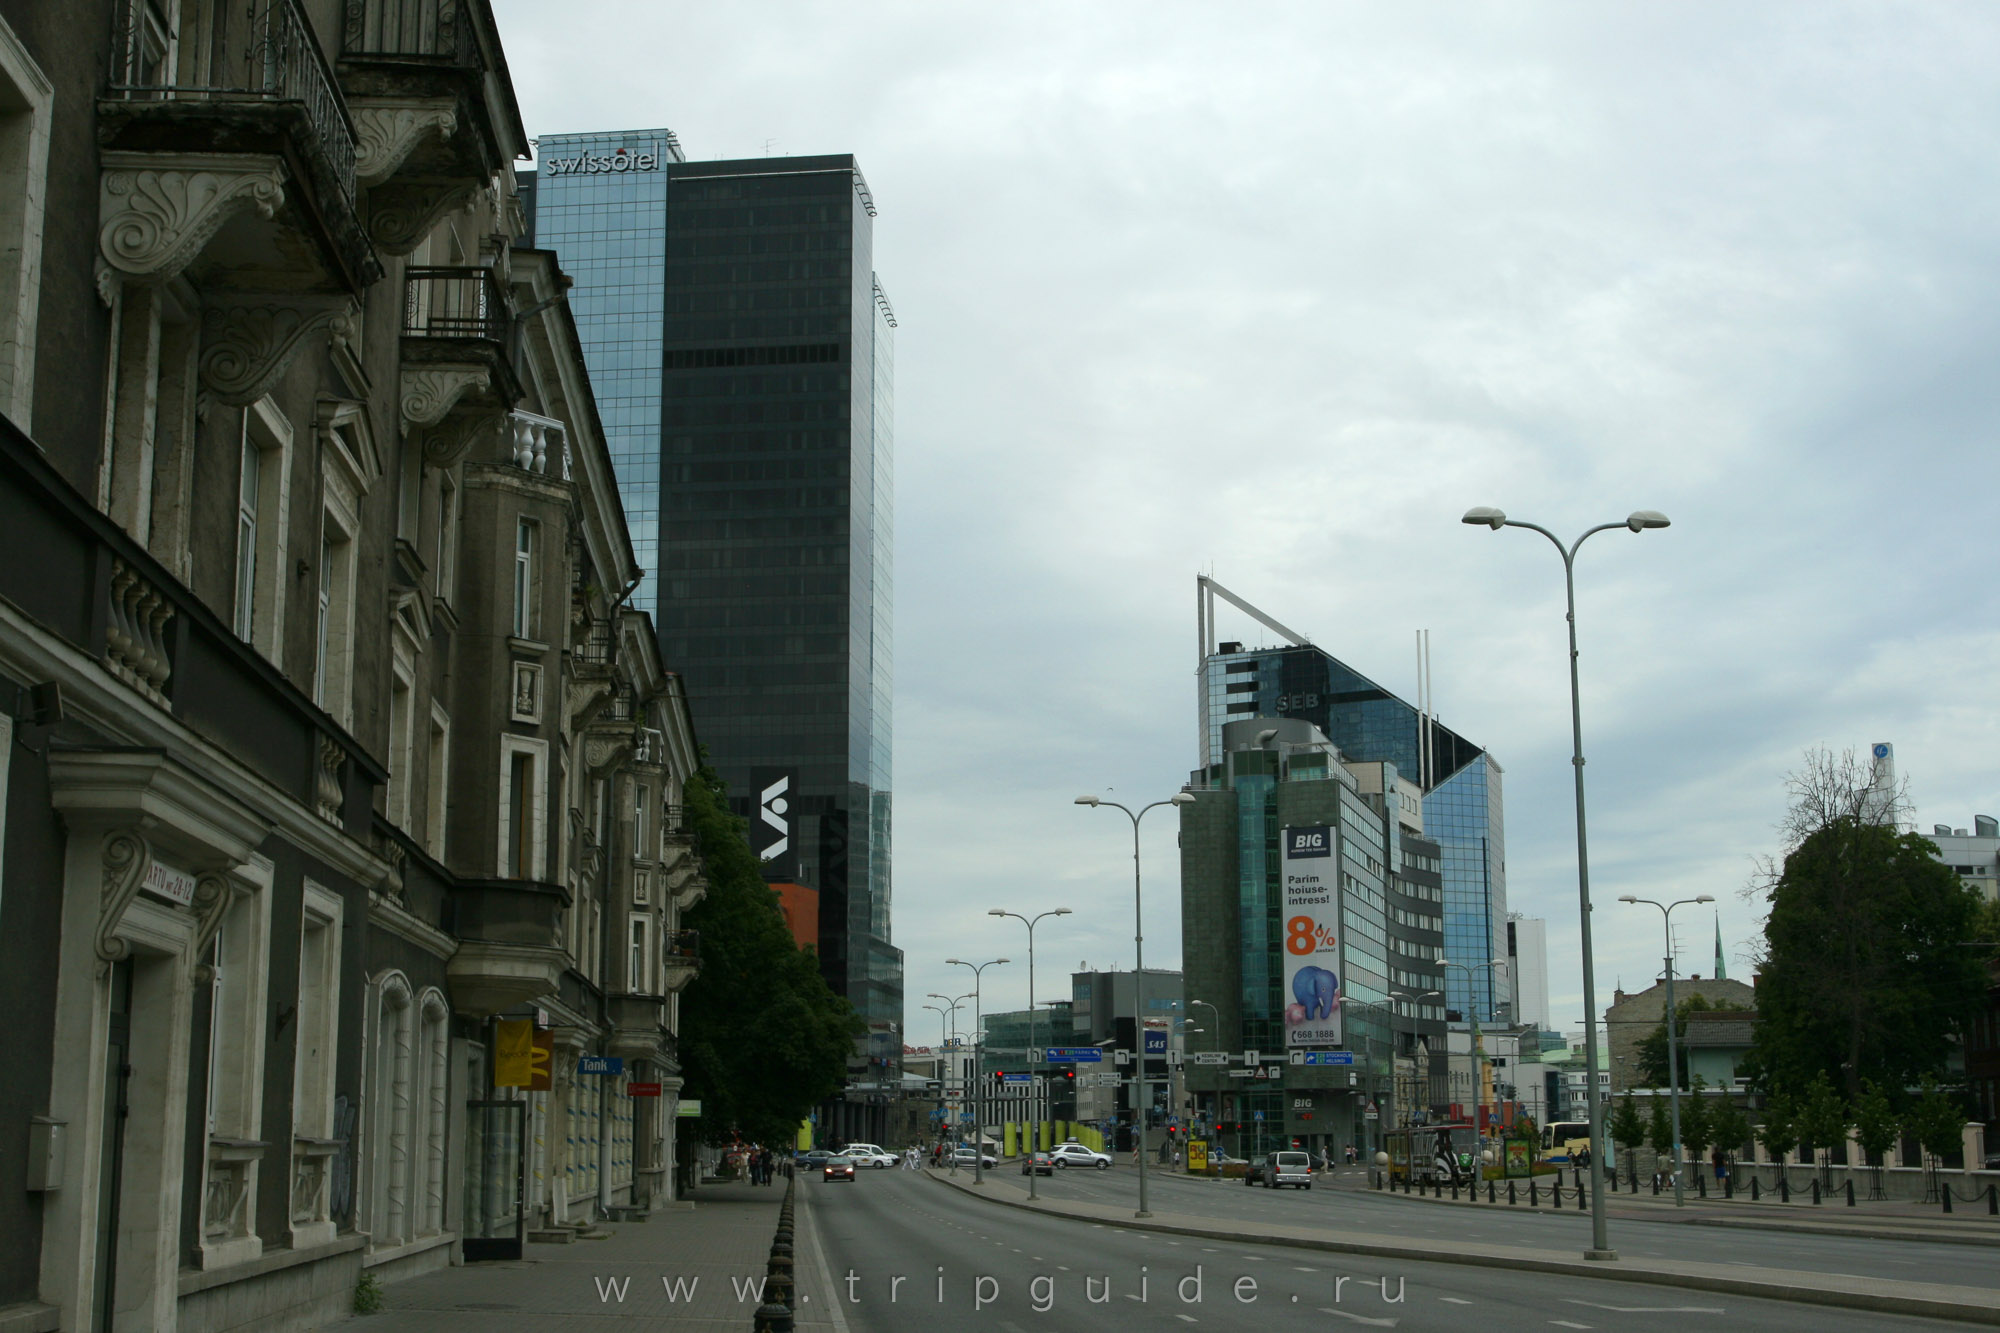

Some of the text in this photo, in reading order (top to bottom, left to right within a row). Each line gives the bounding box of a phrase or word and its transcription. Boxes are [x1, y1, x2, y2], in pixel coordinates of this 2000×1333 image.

[1276, 693, 1319, 712] SEB
[1295, 833, 1322, 848] BIG
[145, 863, 167, 889] ARTU
[1288, 875, 1319, 884] Parim
[1288, 885, 1328, 895] hoiuse-
[1288, 895, 1330, 905] intress!
[1287, 915, 1335, 955] 8%
[1297, 1030, 1334, 1038] 668 1888
[1147, 1040, 1166, 1049] SAS
[582, 1058, 608, 1071] Tank
[1294, 1098, 1312, 1108] BIG
